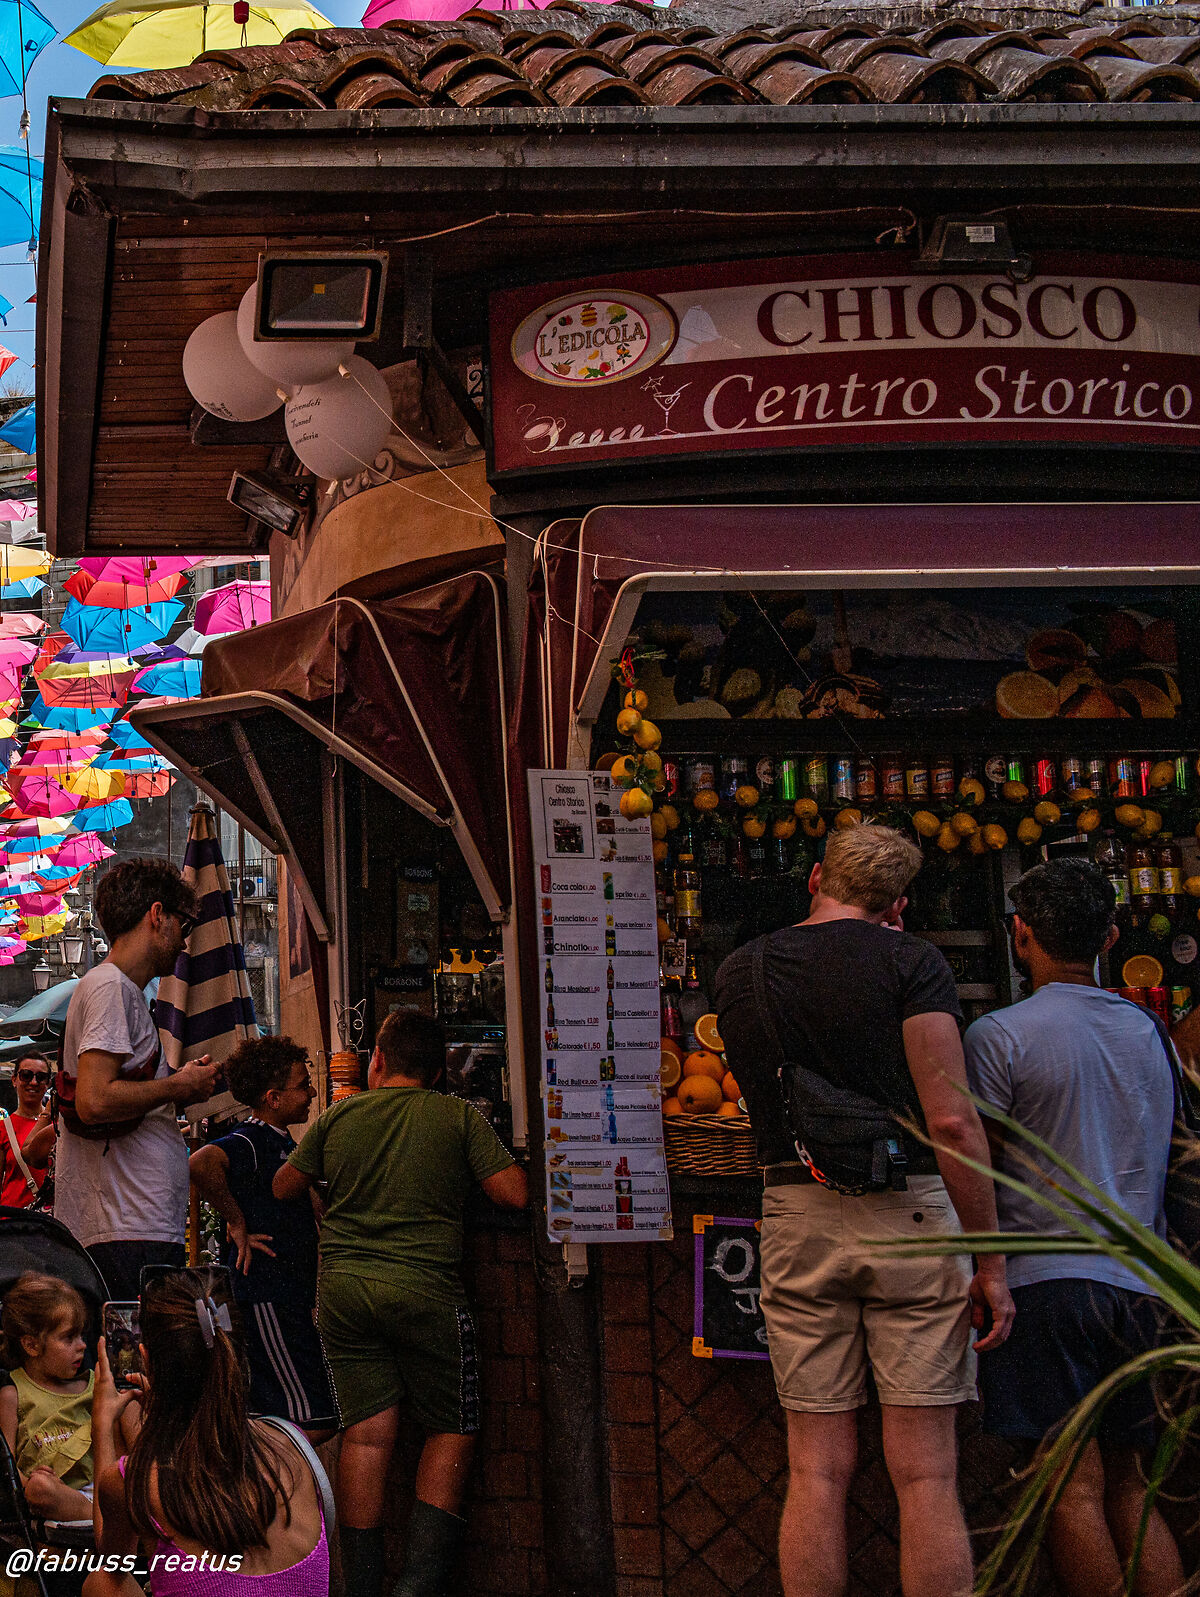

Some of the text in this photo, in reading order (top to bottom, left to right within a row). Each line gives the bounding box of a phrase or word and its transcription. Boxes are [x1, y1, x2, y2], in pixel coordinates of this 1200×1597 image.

[755, 283, 1138, 347] CHIOSCO
[538, 321, 647, 358] L'EDICOLA
[703, 363, 1194, 432] Centro Storico
[555, 784, 575, 794] Chiosco
[548, 797, 585, 807] Centro Storico
[552, 883, 569, 891] Coca
[569, 883, 583, 891] cola
[553, 914, 585, 922] Aranciata
[553, 943, 588, 952] Chinotto
[384, 976, 424, 987] BORBONE
